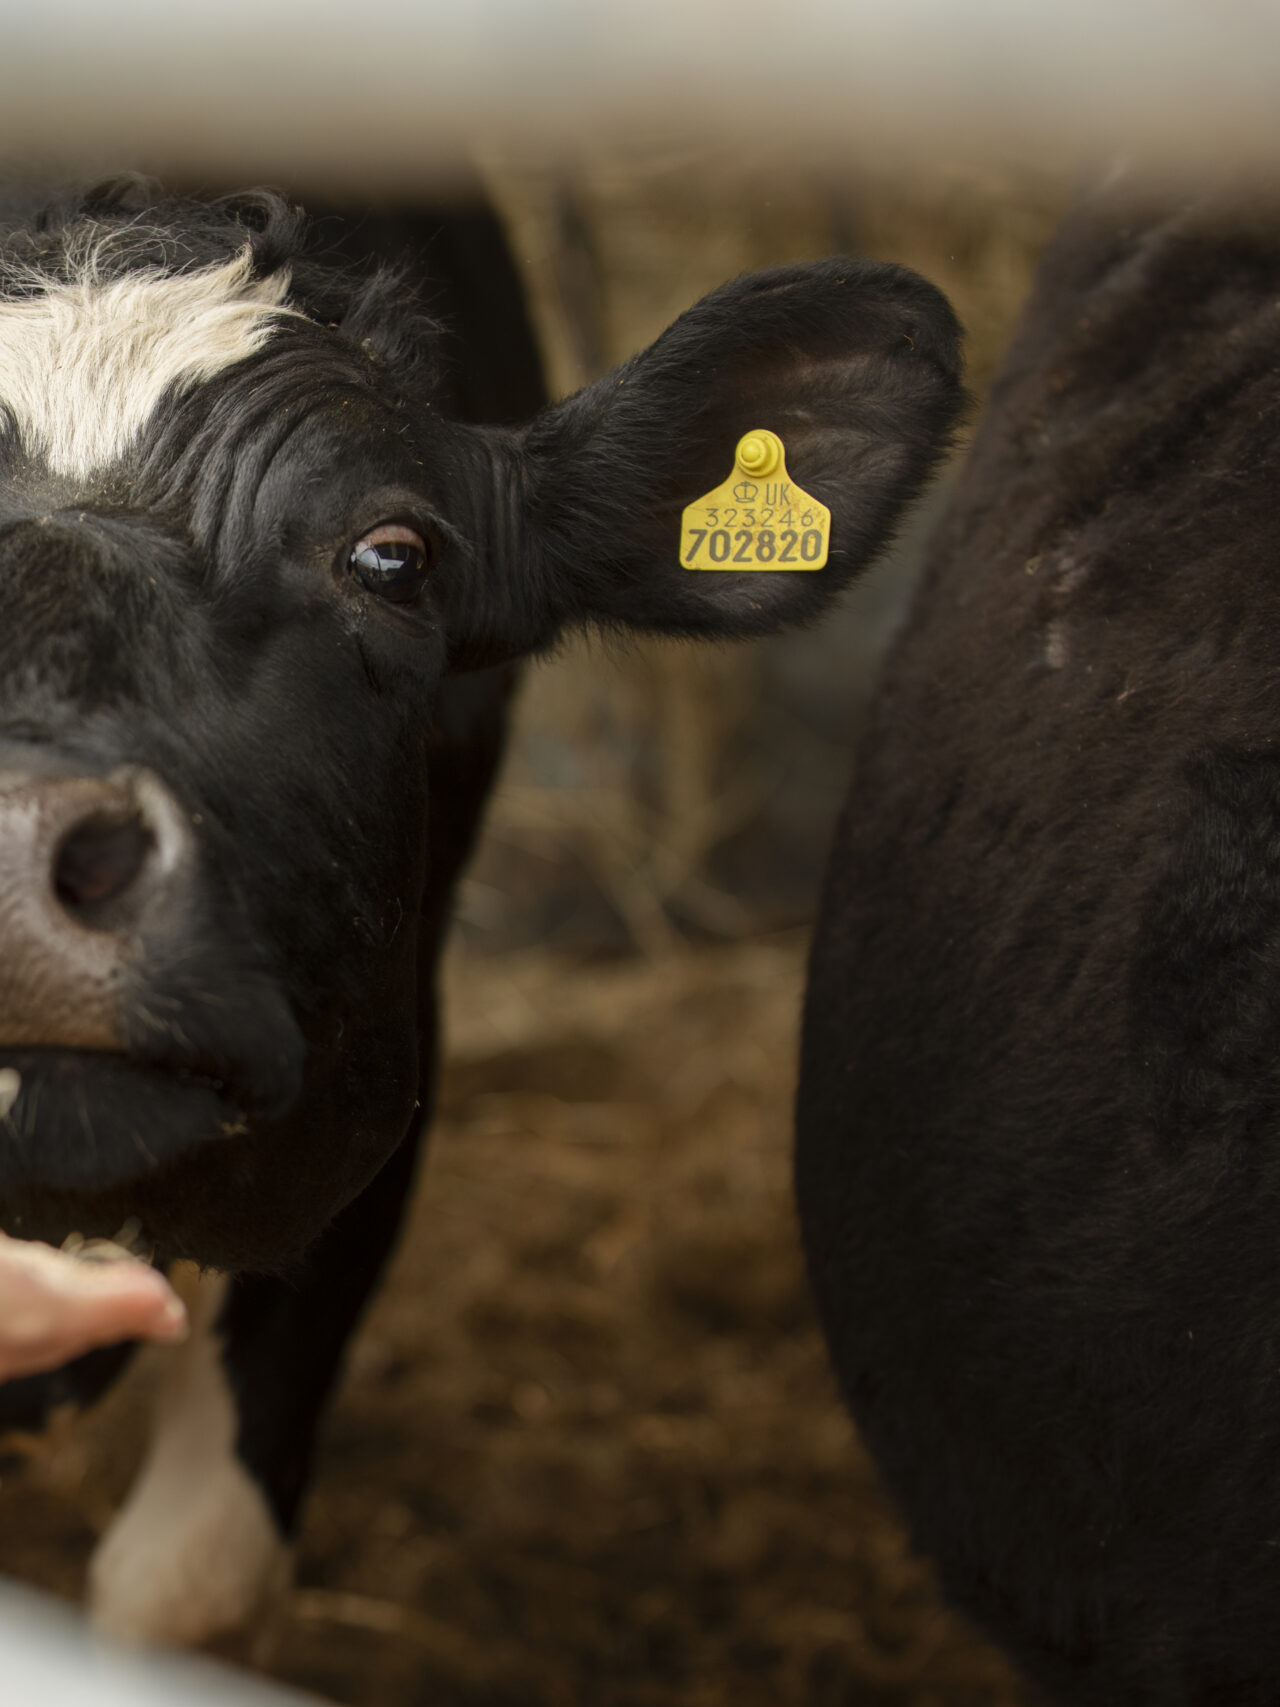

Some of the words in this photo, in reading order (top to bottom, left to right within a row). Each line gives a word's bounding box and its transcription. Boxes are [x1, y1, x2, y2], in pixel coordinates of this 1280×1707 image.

[765, 483, 791, 506] UK
[705, 508, 814, 528] 323246
[685, 529, 823, 562] 702820
